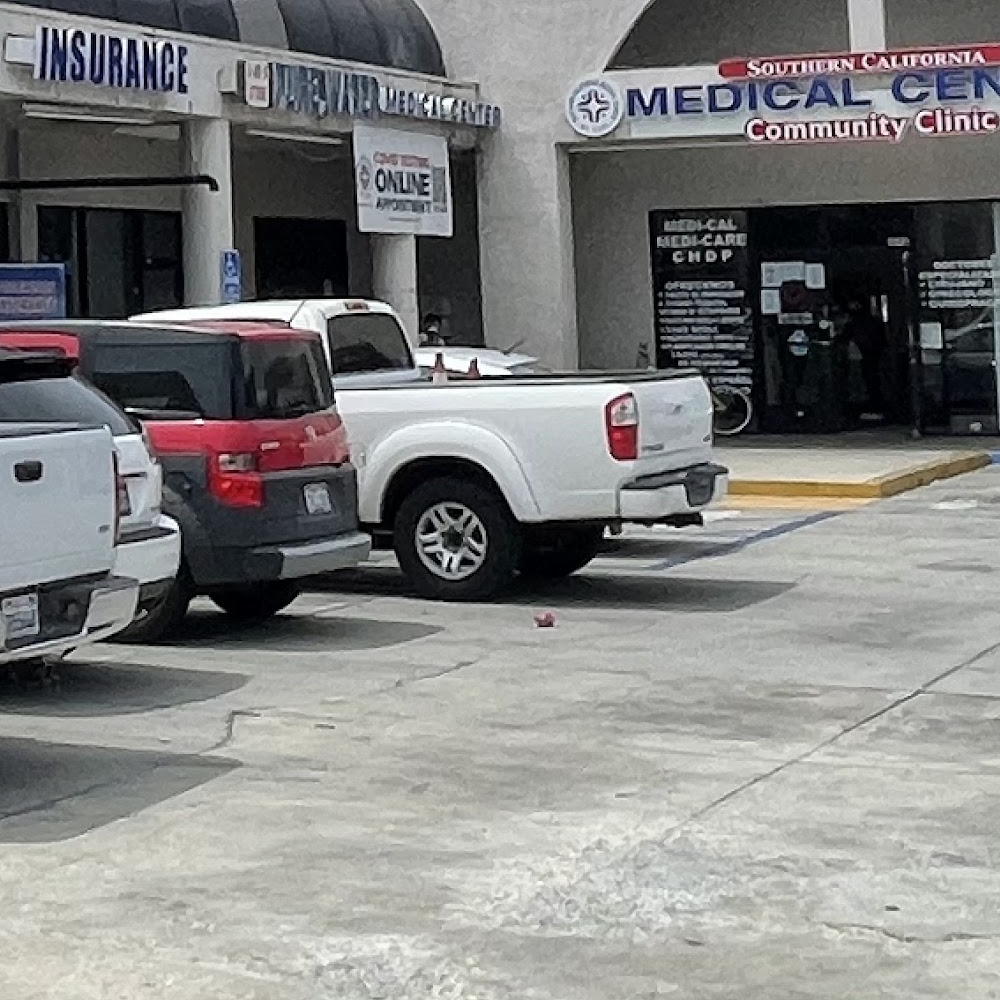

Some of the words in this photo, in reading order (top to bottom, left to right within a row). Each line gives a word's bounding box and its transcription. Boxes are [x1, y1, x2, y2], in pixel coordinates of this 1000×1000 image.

[38, 26, 189, 95] INSURANCE
[746, 57, 856, 78] SOUTHERN
[861, 51, 986, 69] CALIFORNIA
[626, 76, 872, 117] MEDICAL
[747, 112, 906, 140] Community
[915, 106, 996, 133] Clinic
[375, 168, 430, 196] ONLINE
